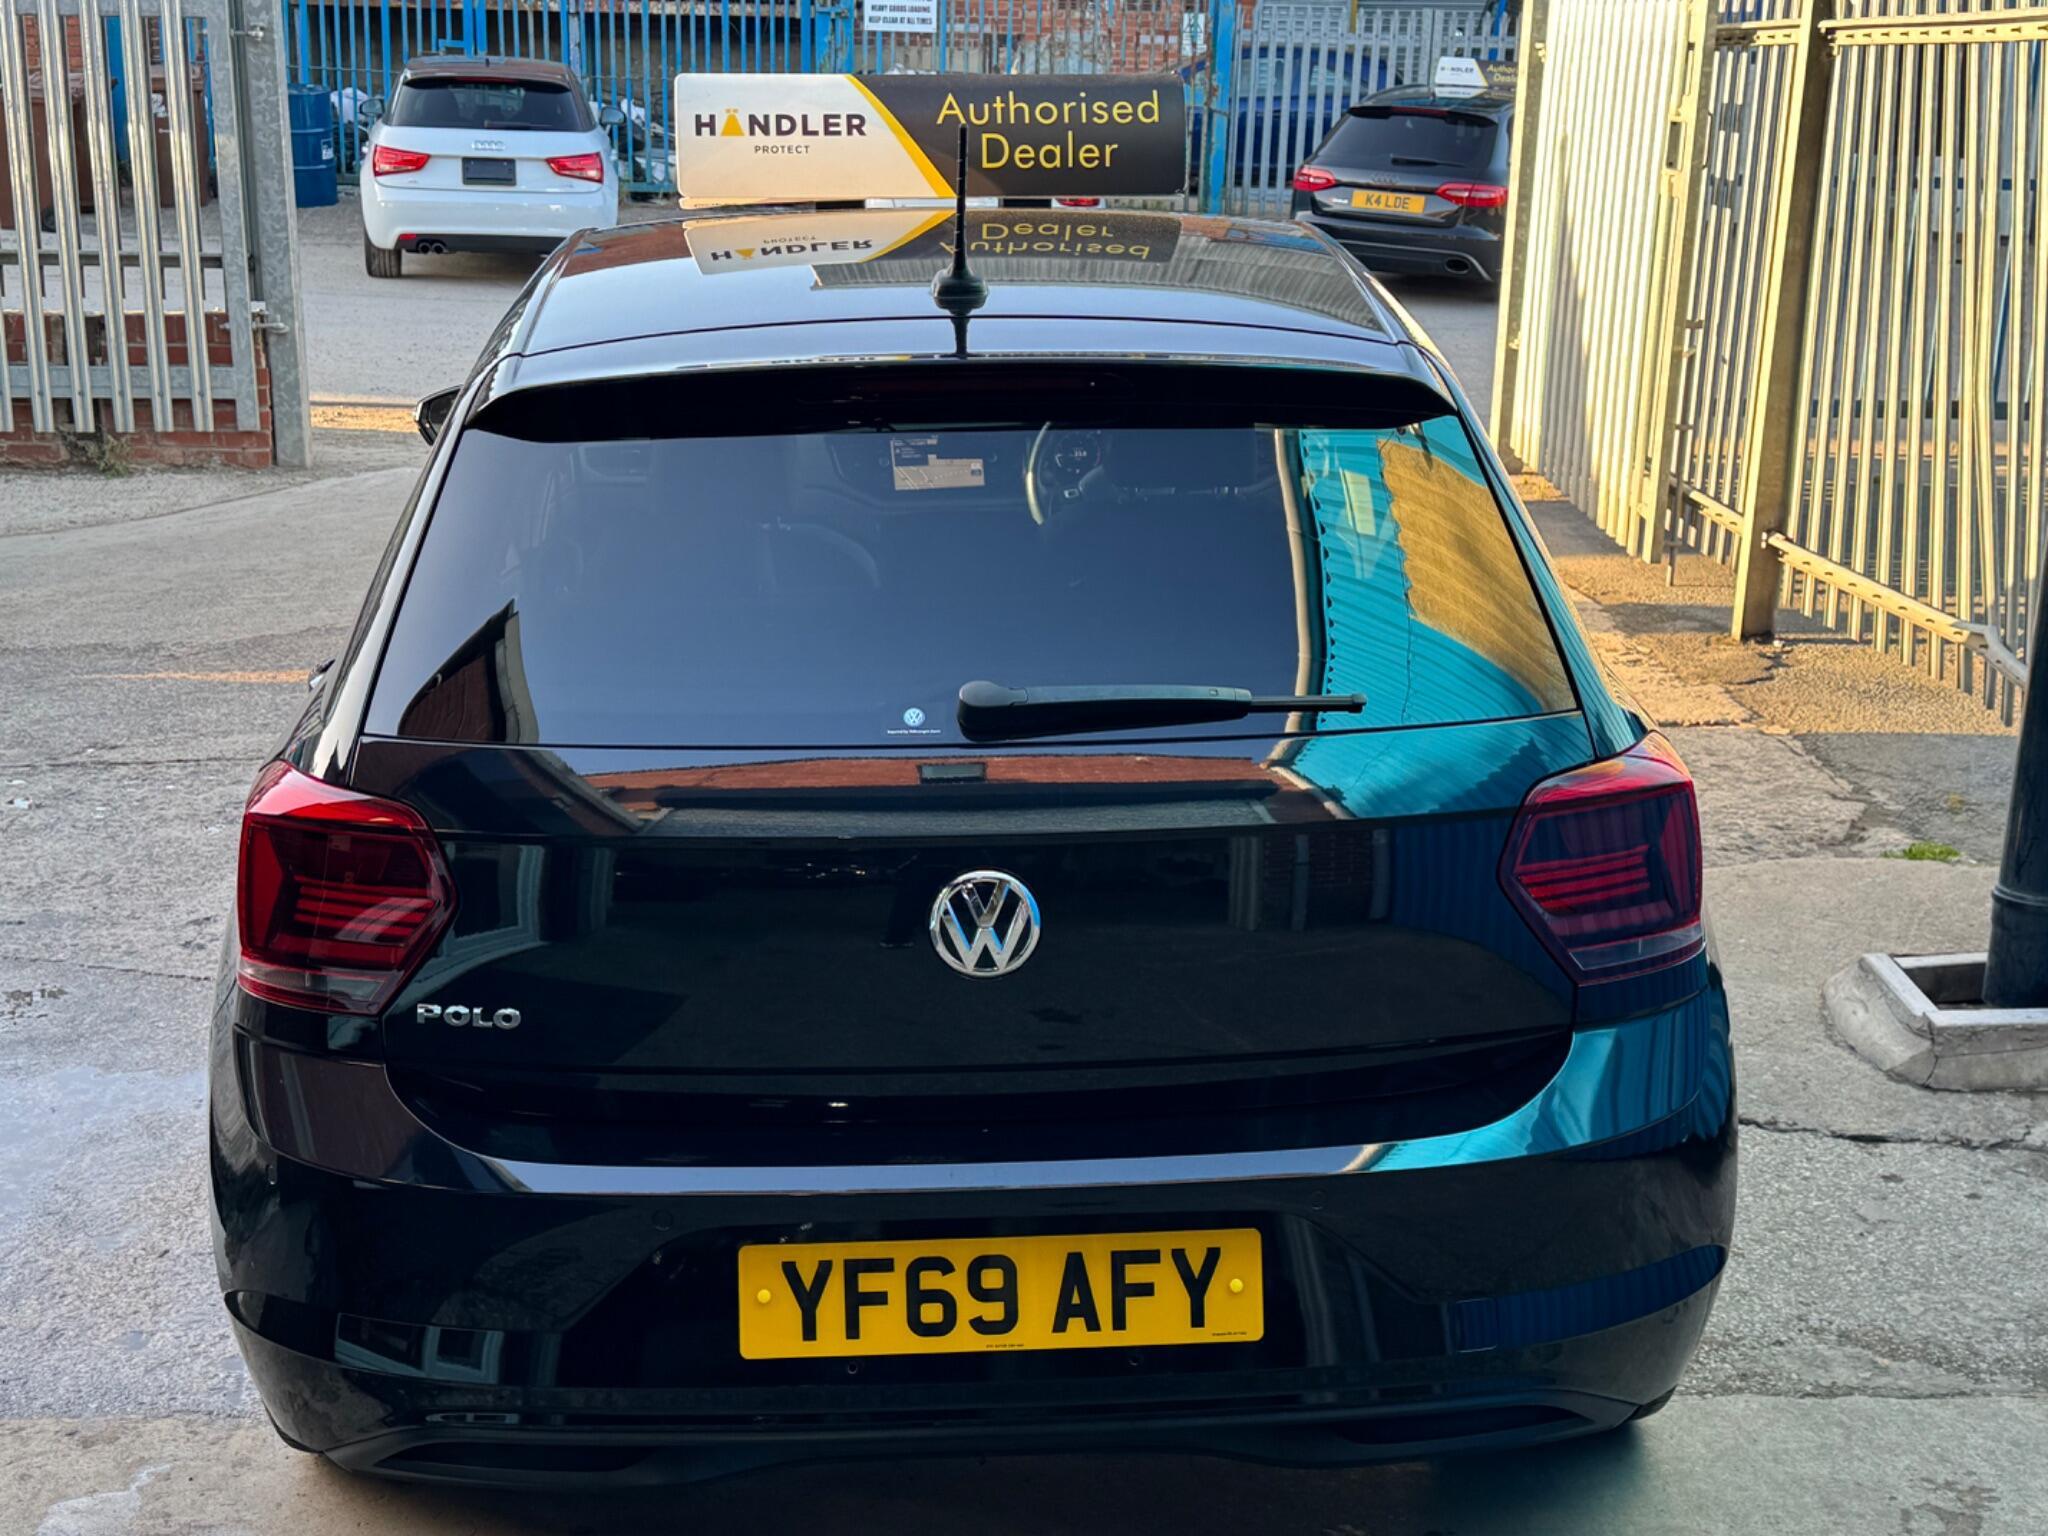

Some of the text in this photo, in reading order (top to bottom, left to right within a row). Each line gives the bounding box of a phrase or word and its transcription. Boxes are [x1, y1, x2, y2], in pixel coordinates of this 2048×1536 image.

[936, 89, 1160, 126] Authorised
[754, 145, 811, 155] PROTECT
[981, 130, 1118, 169] Dealer
[417, 1003, 522, 1030] POLO
[781, 1246, 1221, 1342] YF69 AFY
